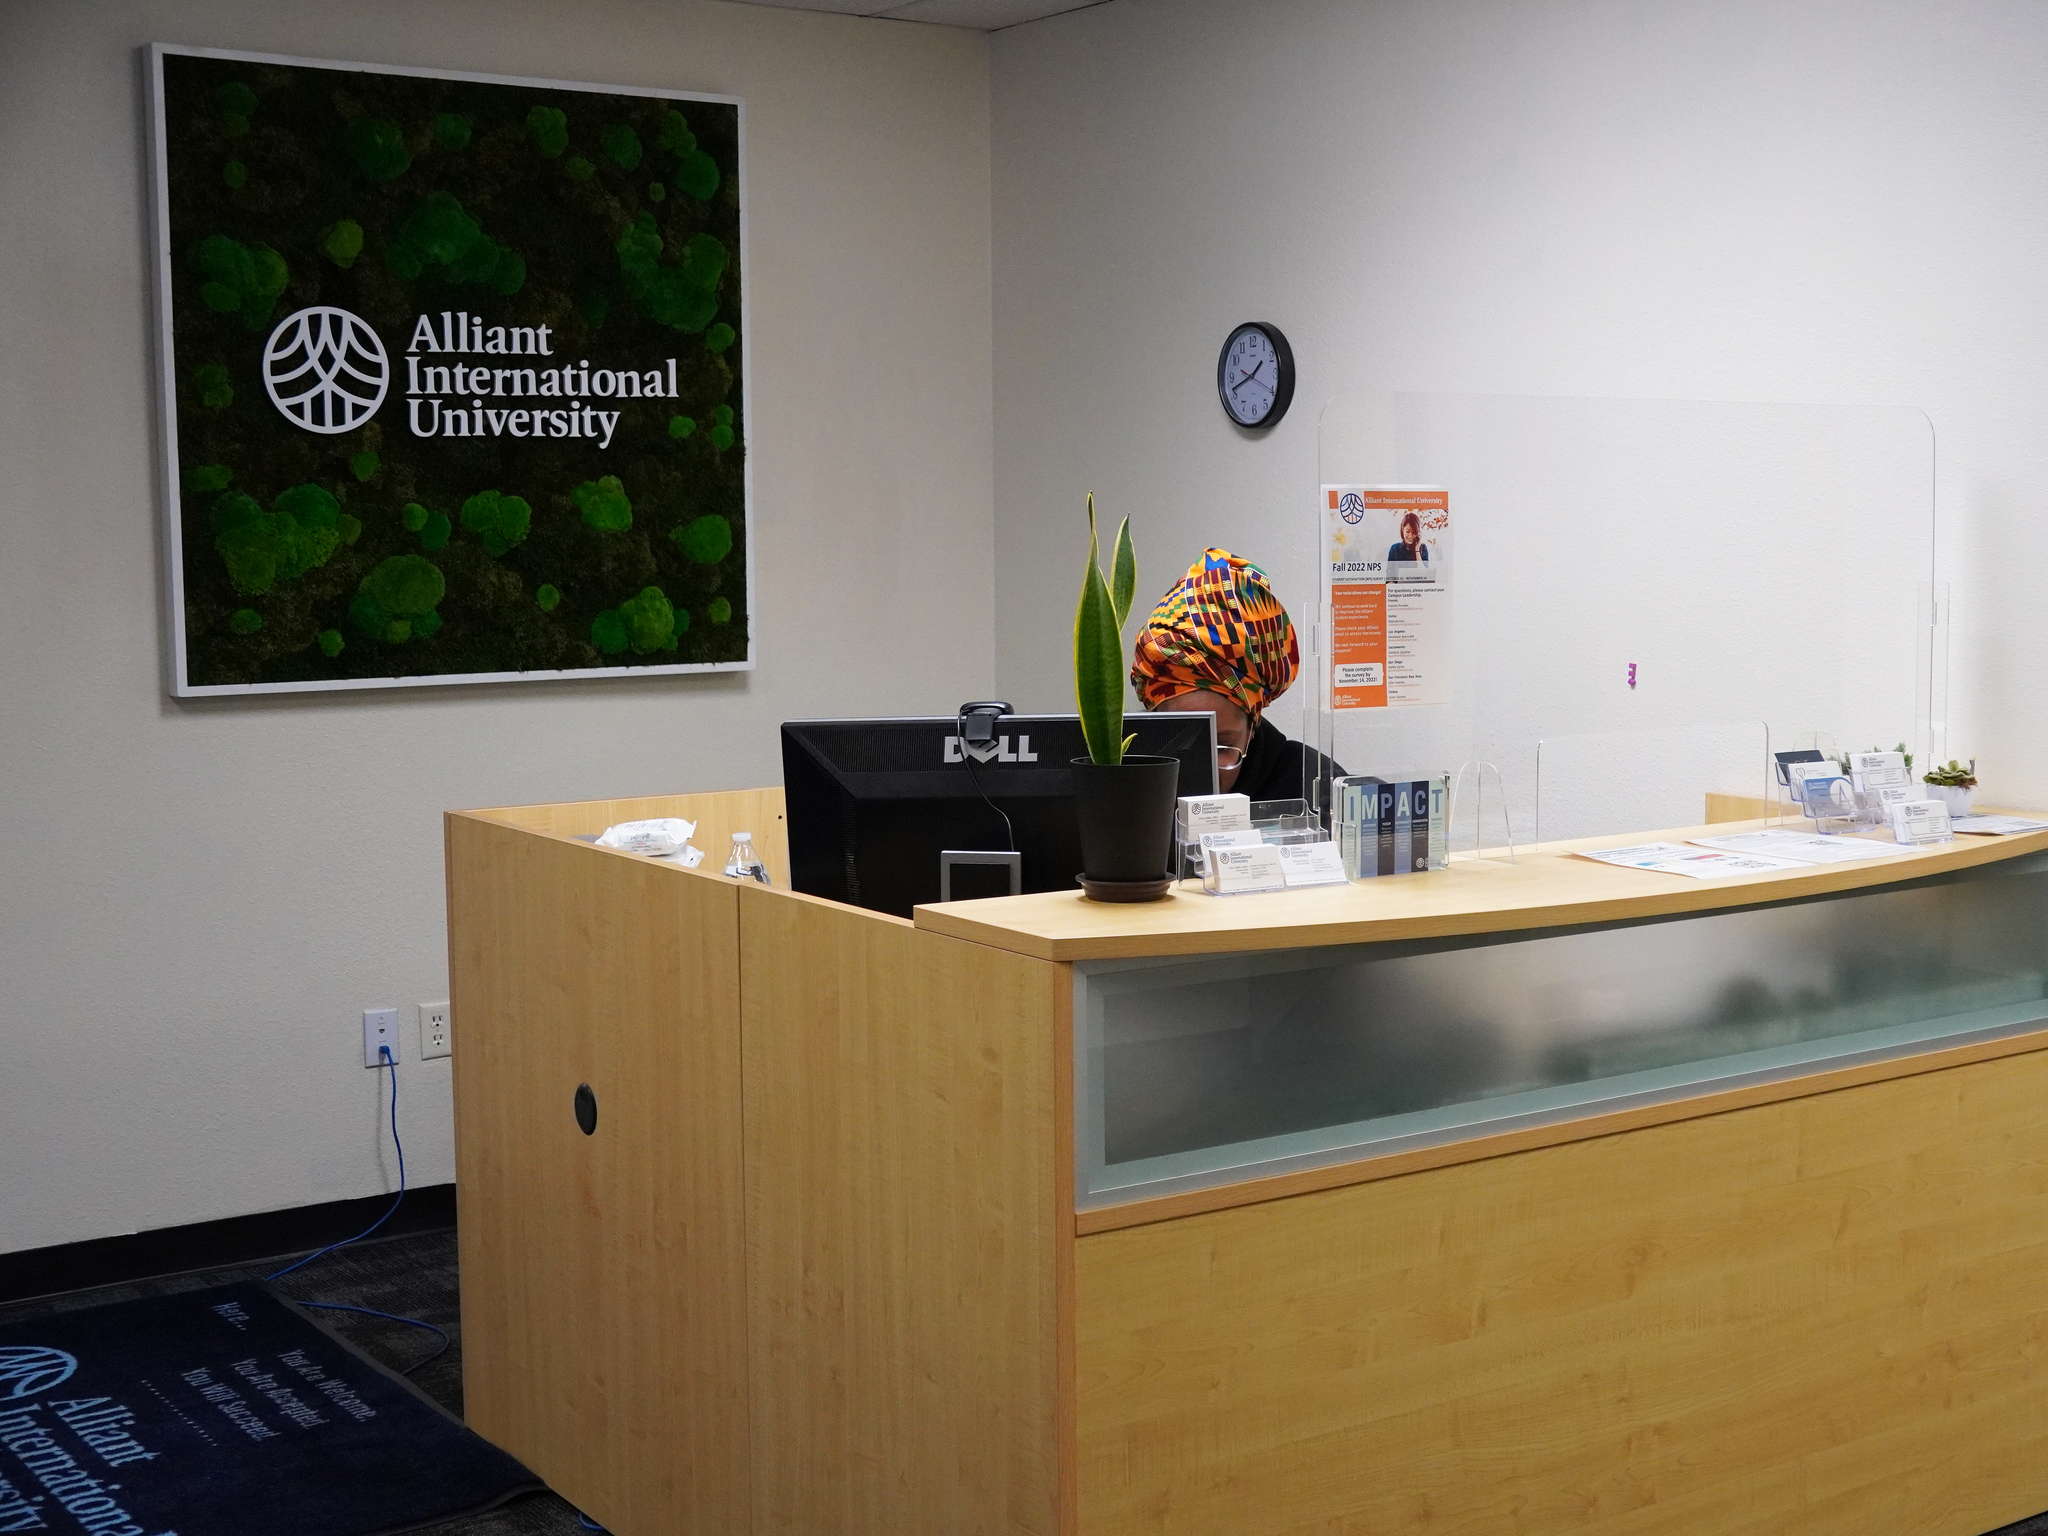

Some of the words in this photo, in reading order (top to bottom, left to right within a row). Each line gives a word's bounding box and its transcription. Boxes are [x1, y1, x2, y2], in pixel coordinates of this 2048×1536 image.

[406, 311, 553, 356] Alliant
[1239, 341, 1246, 354] 11
[1249, 335, 1257, 348] 12
[1262, 340, 1266, 352] 1
[1232, 353, 1240, 366] 10
[404, 356, 679, 399] International
[1229, 372, 1235, 384] 9
[408, 398, 621, 449] University
[1251, 404, 1258, 416] 6
[1365, 496, 1382, 505] Alliant
[1382, 496, 1416, 505] International
[1416, 496, 1444, 506] University
[1332, 563, 1346, 572] Fall
[1347, 562, 1365, 572] 2022
[1366, 562, 1382, 572] NPS
[1348, 788, 1443, 821] IMPACT
[231, 1357, 260, 1376] You
[246, 1373, 279, 1391] Are
[277, 1348, 311, 1367] You
[295, 1365, 326, 1382] Are
[181, 1366, 214, 1387] You
[200, 1382, 241, 1403] Will
[48, 1396, 161, 1468] Alliant
[0, 1403, 178, 1536] Internationa
